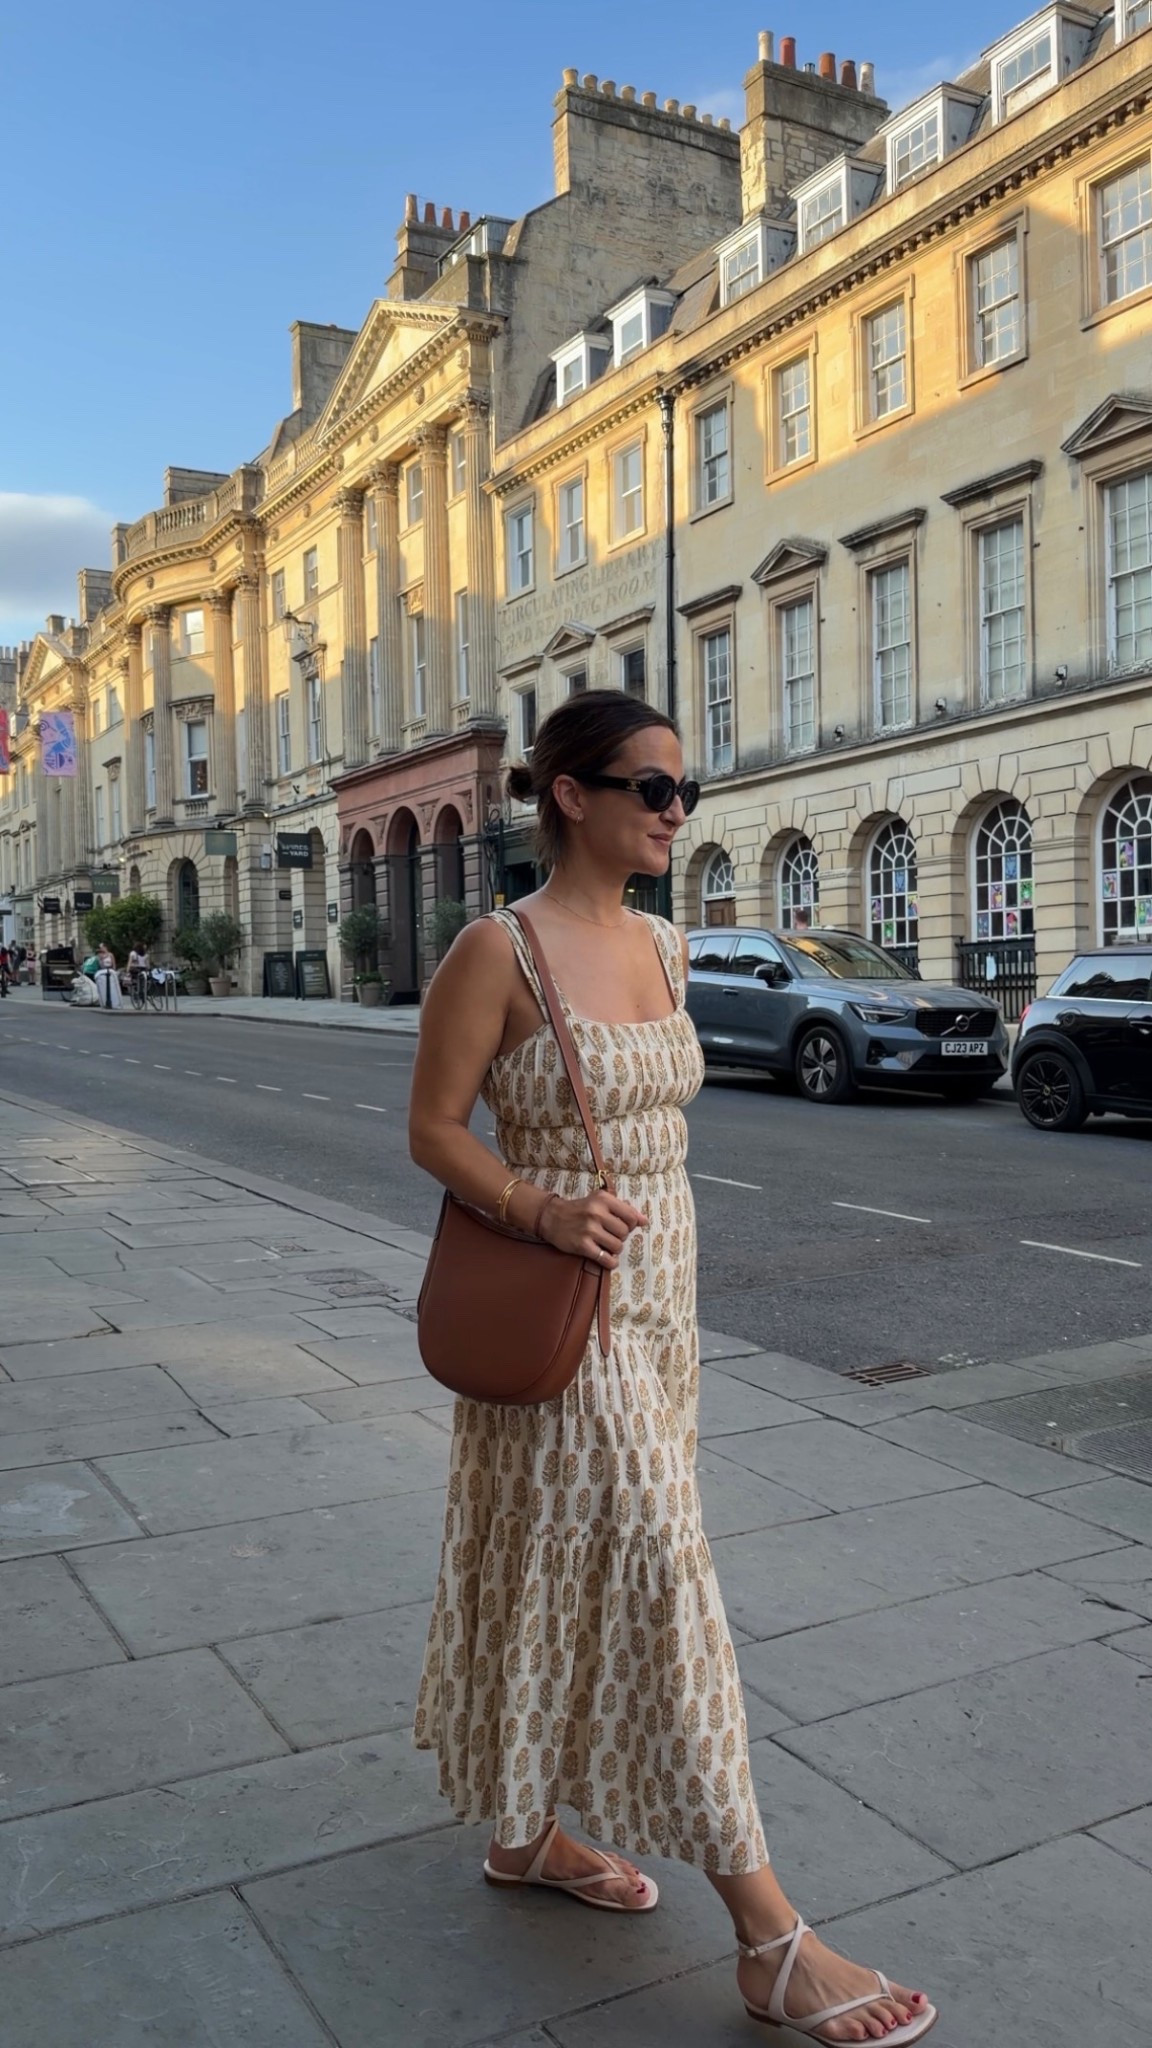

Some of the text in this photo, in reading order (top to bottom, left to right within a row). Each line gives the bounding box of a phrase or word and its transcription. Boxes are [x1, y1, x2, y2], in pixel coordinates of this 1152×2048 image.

[501, 572, 589, 627] CIRCULATING
[535, 594, 601, 640] REDING
[945, 1043, 984, 1053] CJ23 APZ
